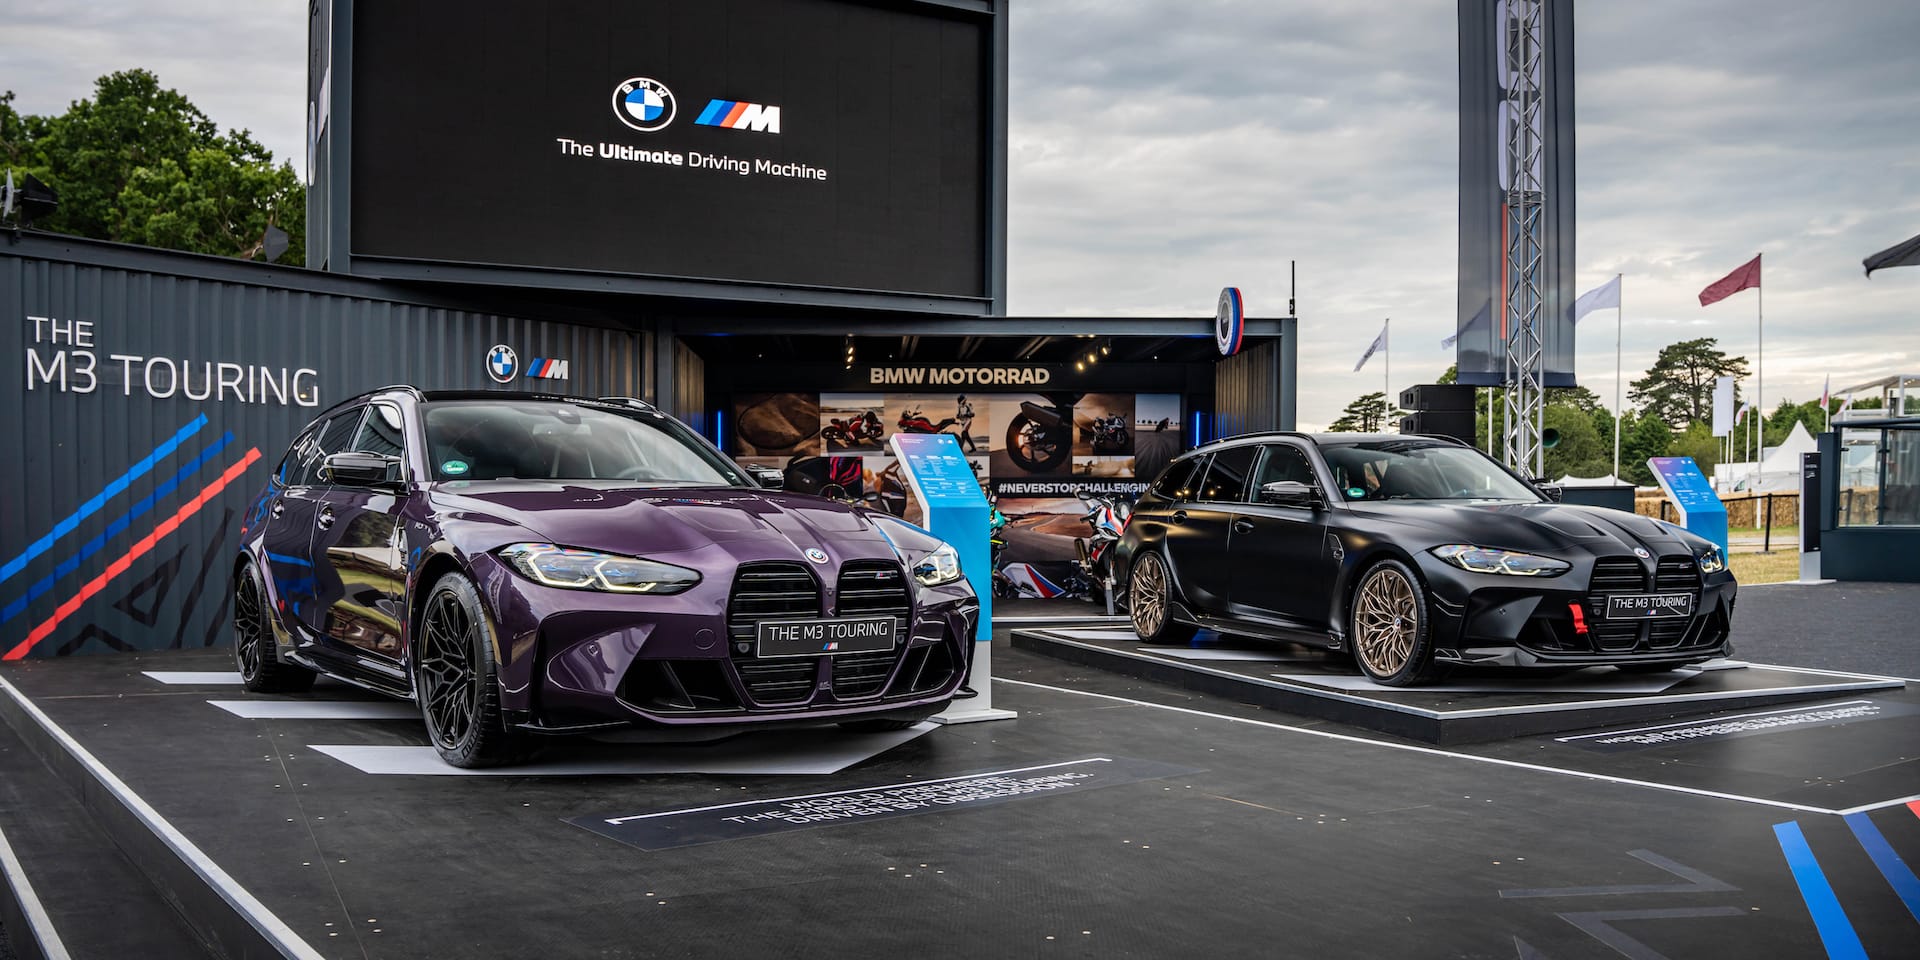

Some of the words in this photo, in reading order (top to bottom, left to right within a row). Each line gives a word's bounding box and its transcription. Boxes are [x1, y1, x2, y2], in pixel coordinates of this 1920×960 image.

[622, 81, 669, 98] BMW
[732, 103, 781, 134] M
[557, 138, 594, 157] The
[599, 142, 683, 165] Ultimate
[688, 151, 750, 175] Driving
[755, 159, 827, 181] Machine
[27, 315, 94, 348] THE
[27, 348, 97, 394] M3
[110, 354, 319, 407] TOURING
[544, 359, 569, 380] M
[870, 367, 926, 385] BMW
[929, 367, 1050, 385] MOTORRAD
[1614, 598, 1634, 609] THE
[1635, 598, 1649, 608] M3
[1650, 596, 1687, 608] TOURING
[768, 626, 800, 641] THE
[803, 625, 824, 640] M3
[828, 621, 888, 639] TOURING
[721, 810, 792, 824] THE
[790, 792, 948, 816] FIRST-EVER
[781, 792, 884, 808] WORLD
[784, 805, 895, 824] DRIVEN
[891, 801, 930, 810] BY
